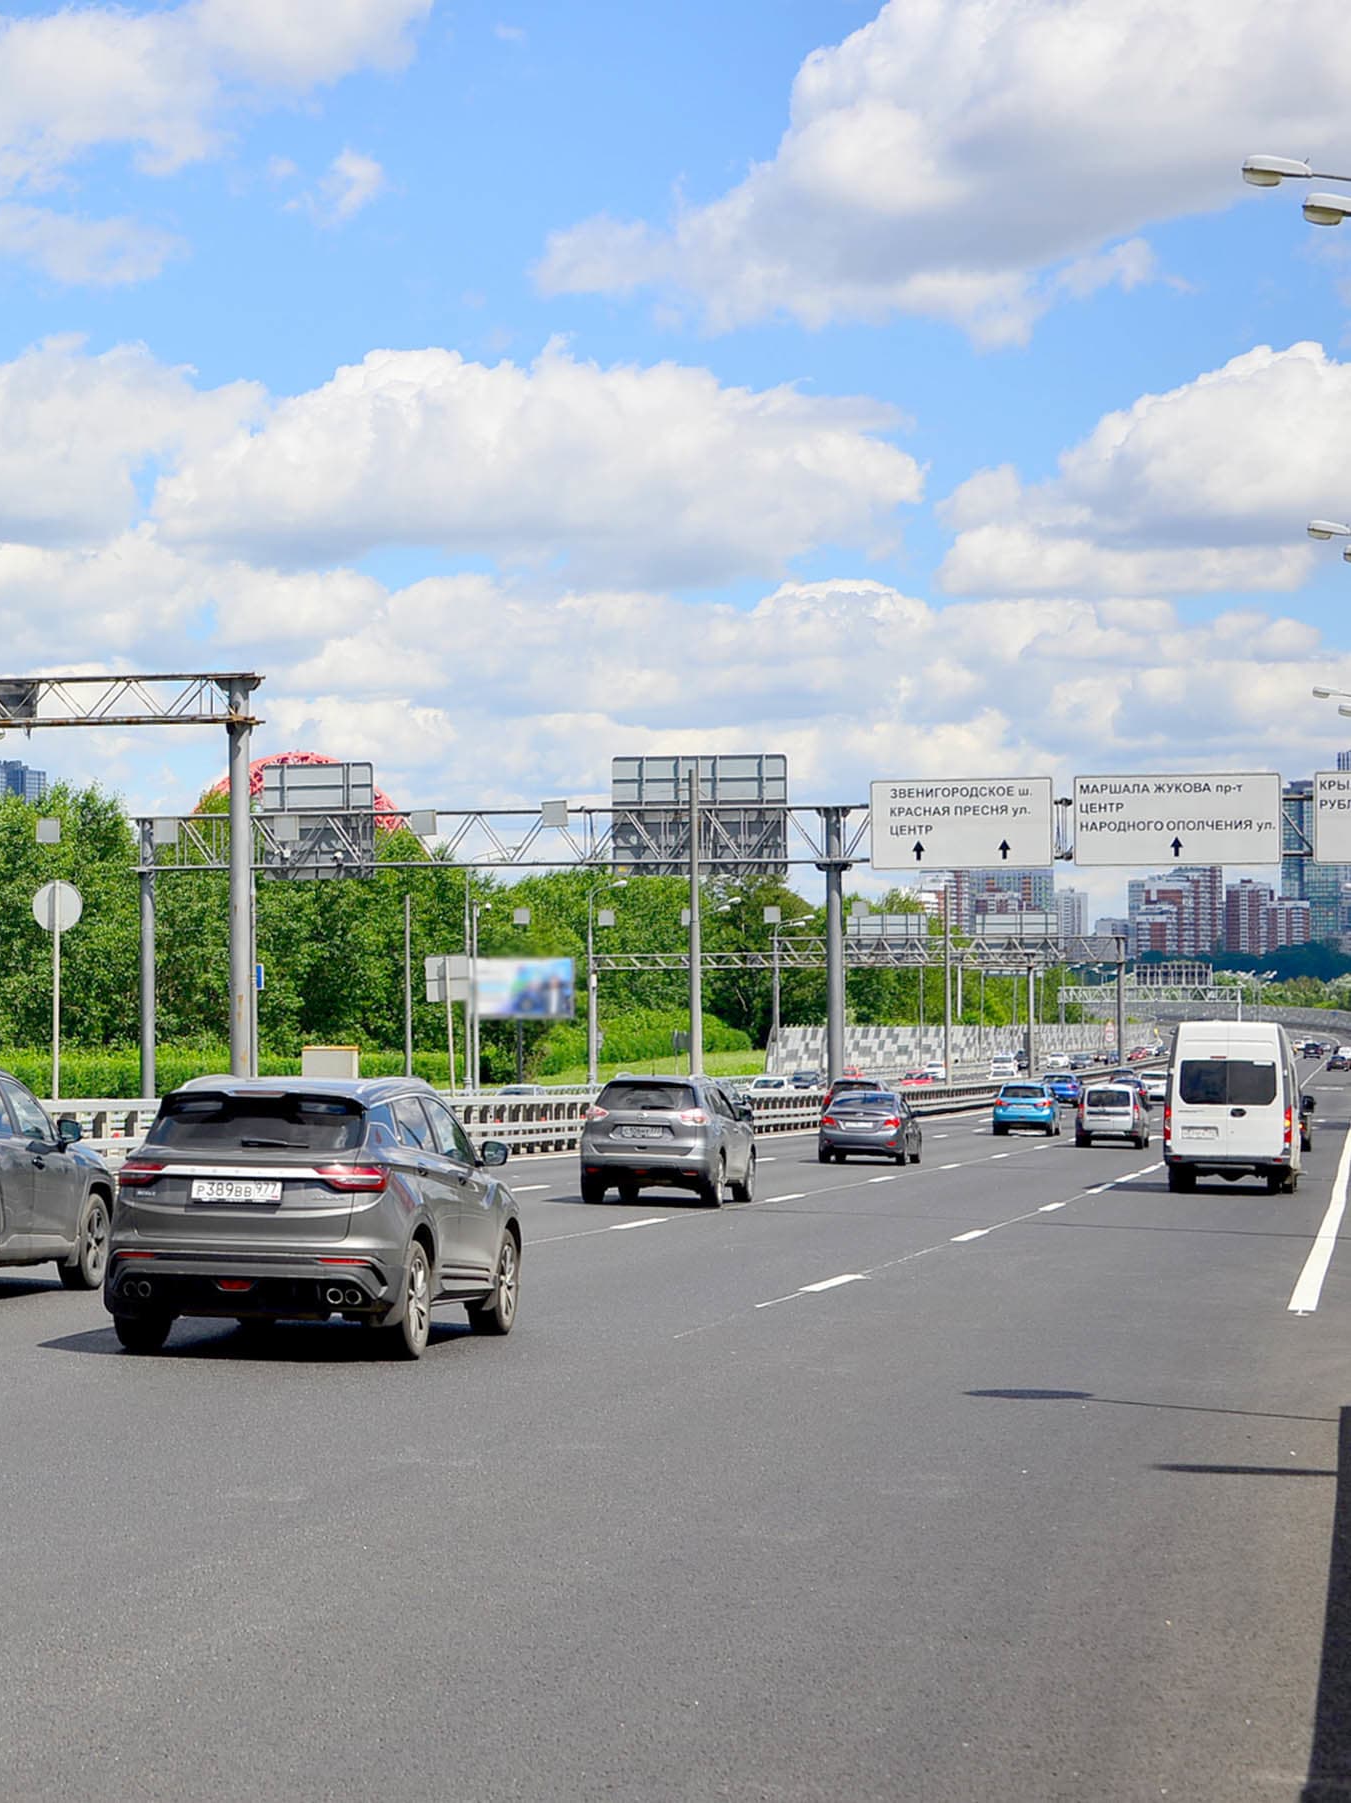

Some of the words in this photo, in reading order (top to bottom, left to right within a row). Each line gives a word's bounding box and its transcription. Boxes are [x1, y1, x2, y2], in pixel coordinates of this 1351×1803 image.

[1079, 783, 1151, 795] МАРШАЛА
[1154, 782, 1212, 794] ЖУКОВА
[1215, 784, 1242, 796] пр-т
[1319, 780, 1351, 791] КРЫ
[890, 786, 1014, 799] ЗВЕНИГОРОДСКОЕ
[1018, 787, 1031, 797] ш.
[889, 806, 951, 817] КРАСНАЯ
[954, 805, 1009, 816] ПРЕСНЯ
[1013, 806, 1031, 818] ул.
[1079, 802, 1125, 815] ЦЕНТР
[890, 824, 933, 837] ЦЕНТР
[1079, 820, 1164, 833] НАРОДНОГО
[1166, 819, 1253, 831] ОПОЛЧЕНИЯ
[1256, 821, 1276, 833] ул.
